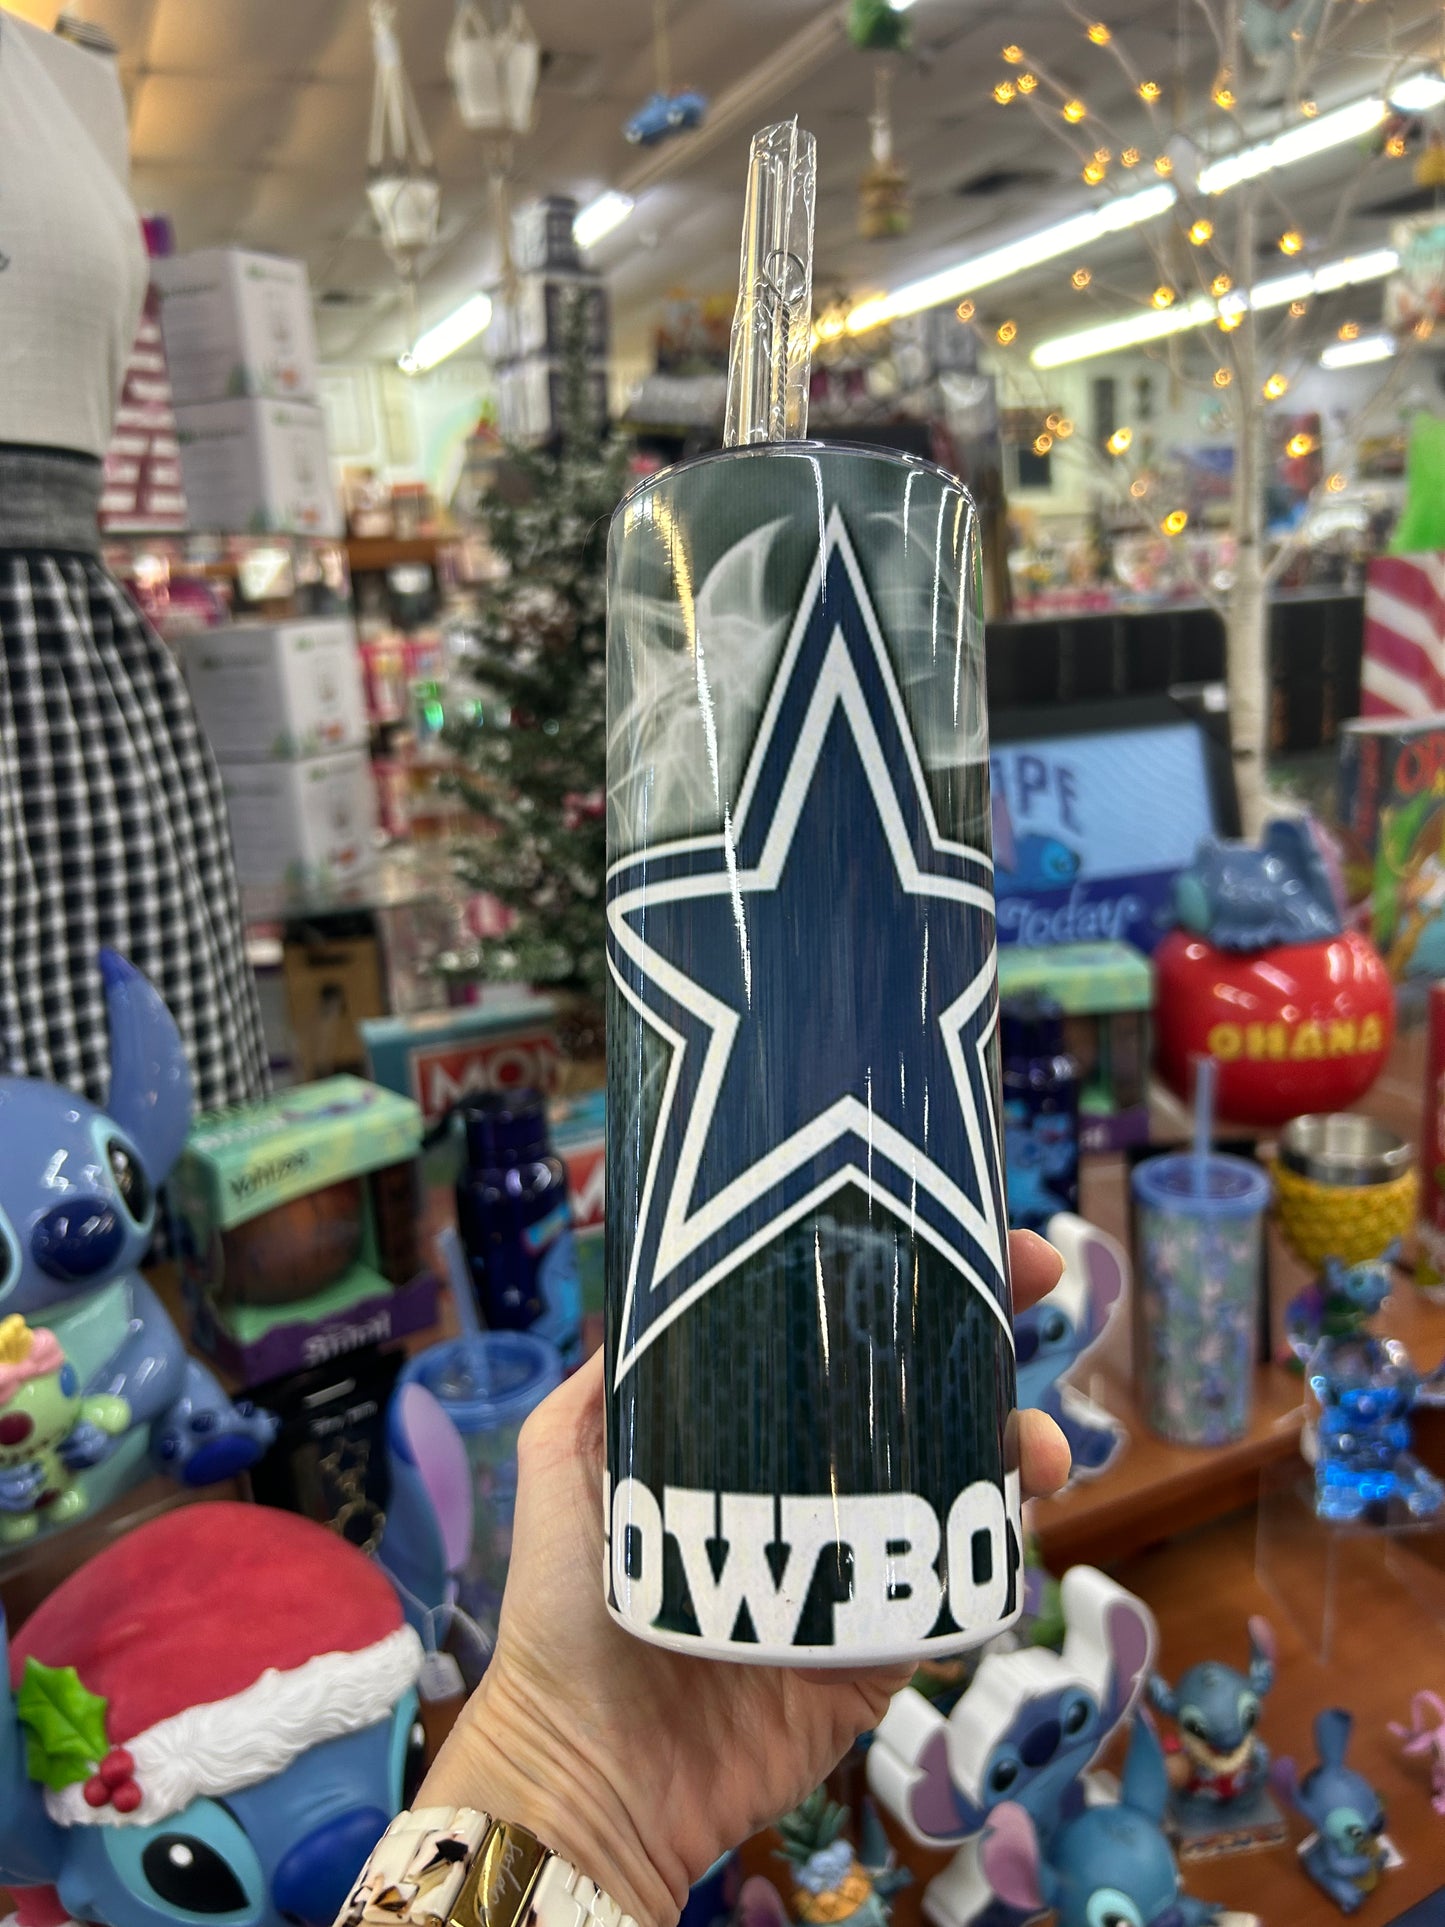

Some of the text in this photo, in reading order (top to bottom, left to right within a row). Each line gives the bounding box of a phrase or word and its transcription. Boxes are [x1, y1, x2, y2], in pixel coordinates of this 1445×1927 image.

[997, 881, 1138, 945] Today
[1208, 1013, 1382, 1063] OHANA
[604, 1470, 1022, 1645] OWBO
